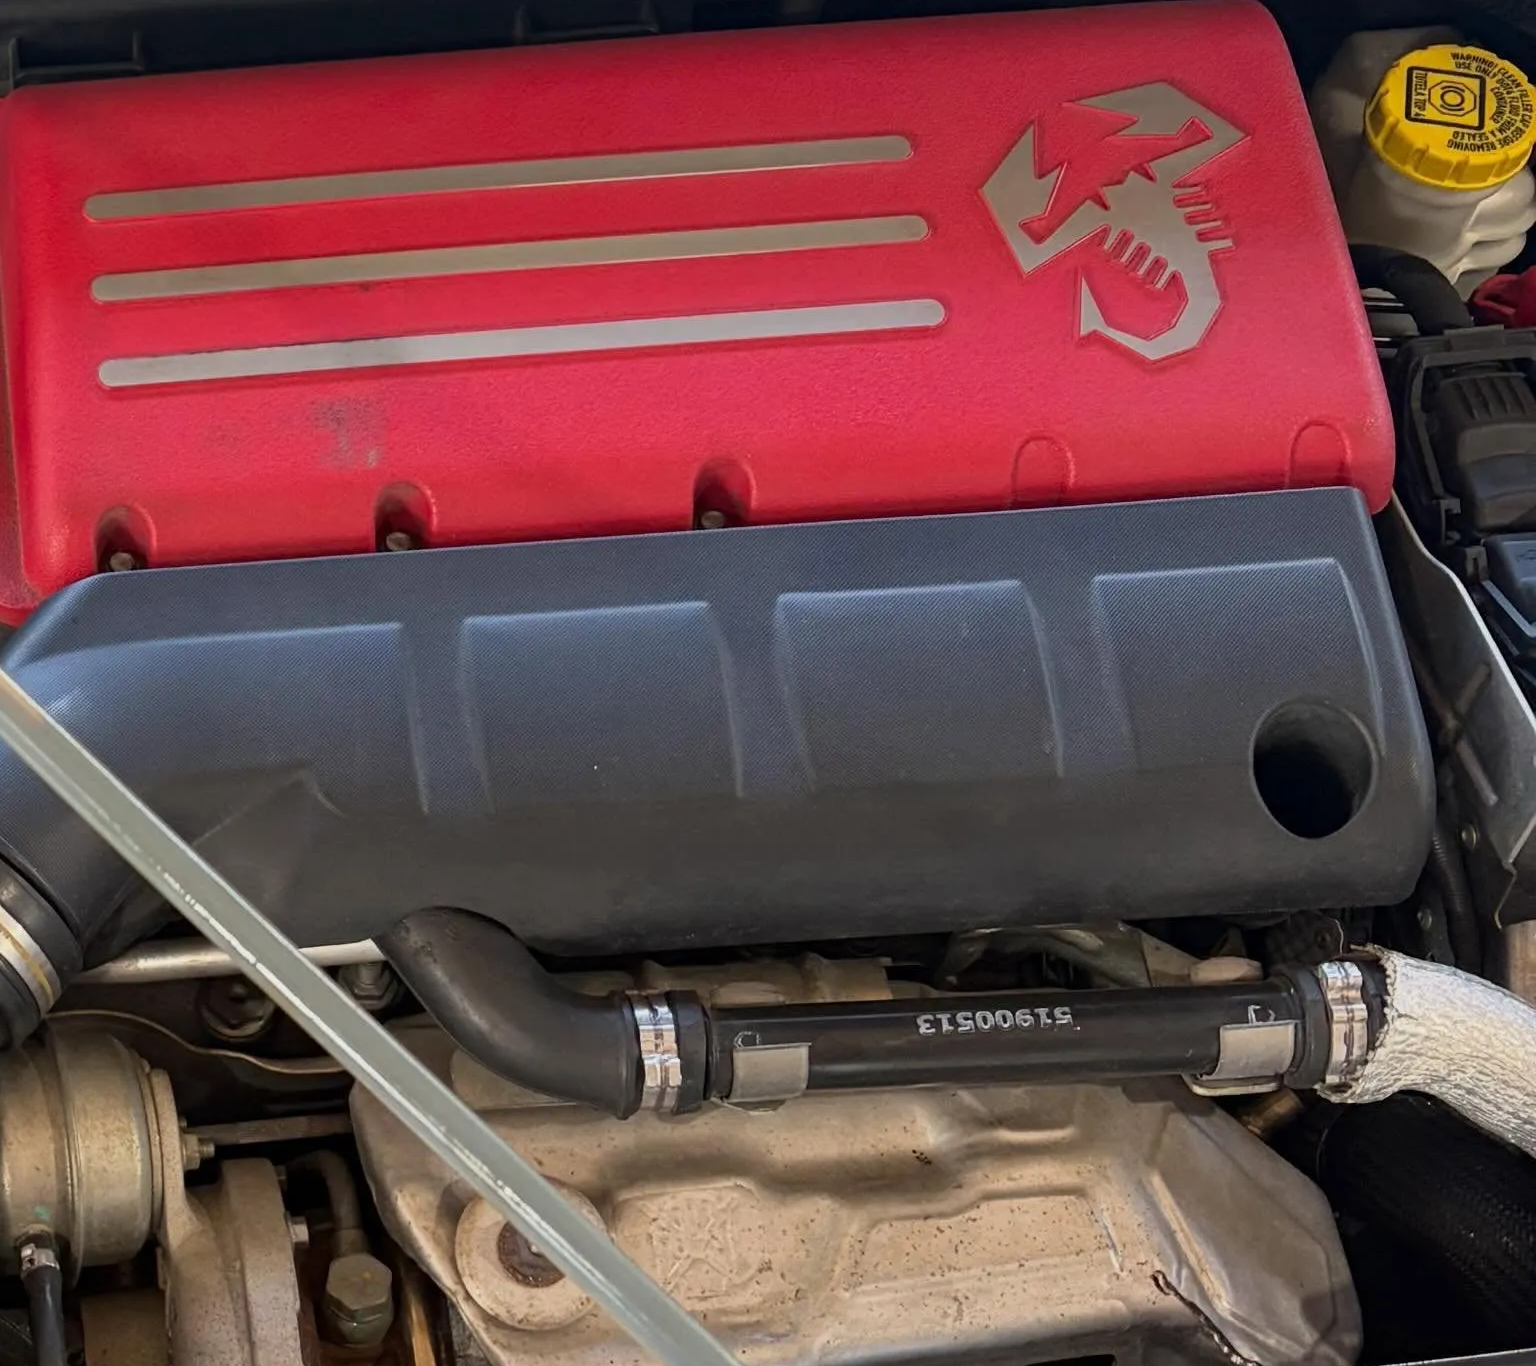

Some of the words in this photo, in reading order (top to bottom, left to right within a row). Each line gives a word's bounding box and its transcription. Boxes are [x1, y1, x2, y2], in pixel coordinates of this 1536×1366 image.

[1451, 52, 1498, 70] WARNING!
[1455, 61, 1473, 71] USE
[1475, 64, 1498, 79] ONLY
[1415, 72, 1428, 96] TUTELA
[1415, 96, 1426, 111] TOP
[1453, 131, 1489, 141] SEALED
[1447, 139, 1497, 152] REMOVING
[916, 1006, 1075, 1036] 51900513
